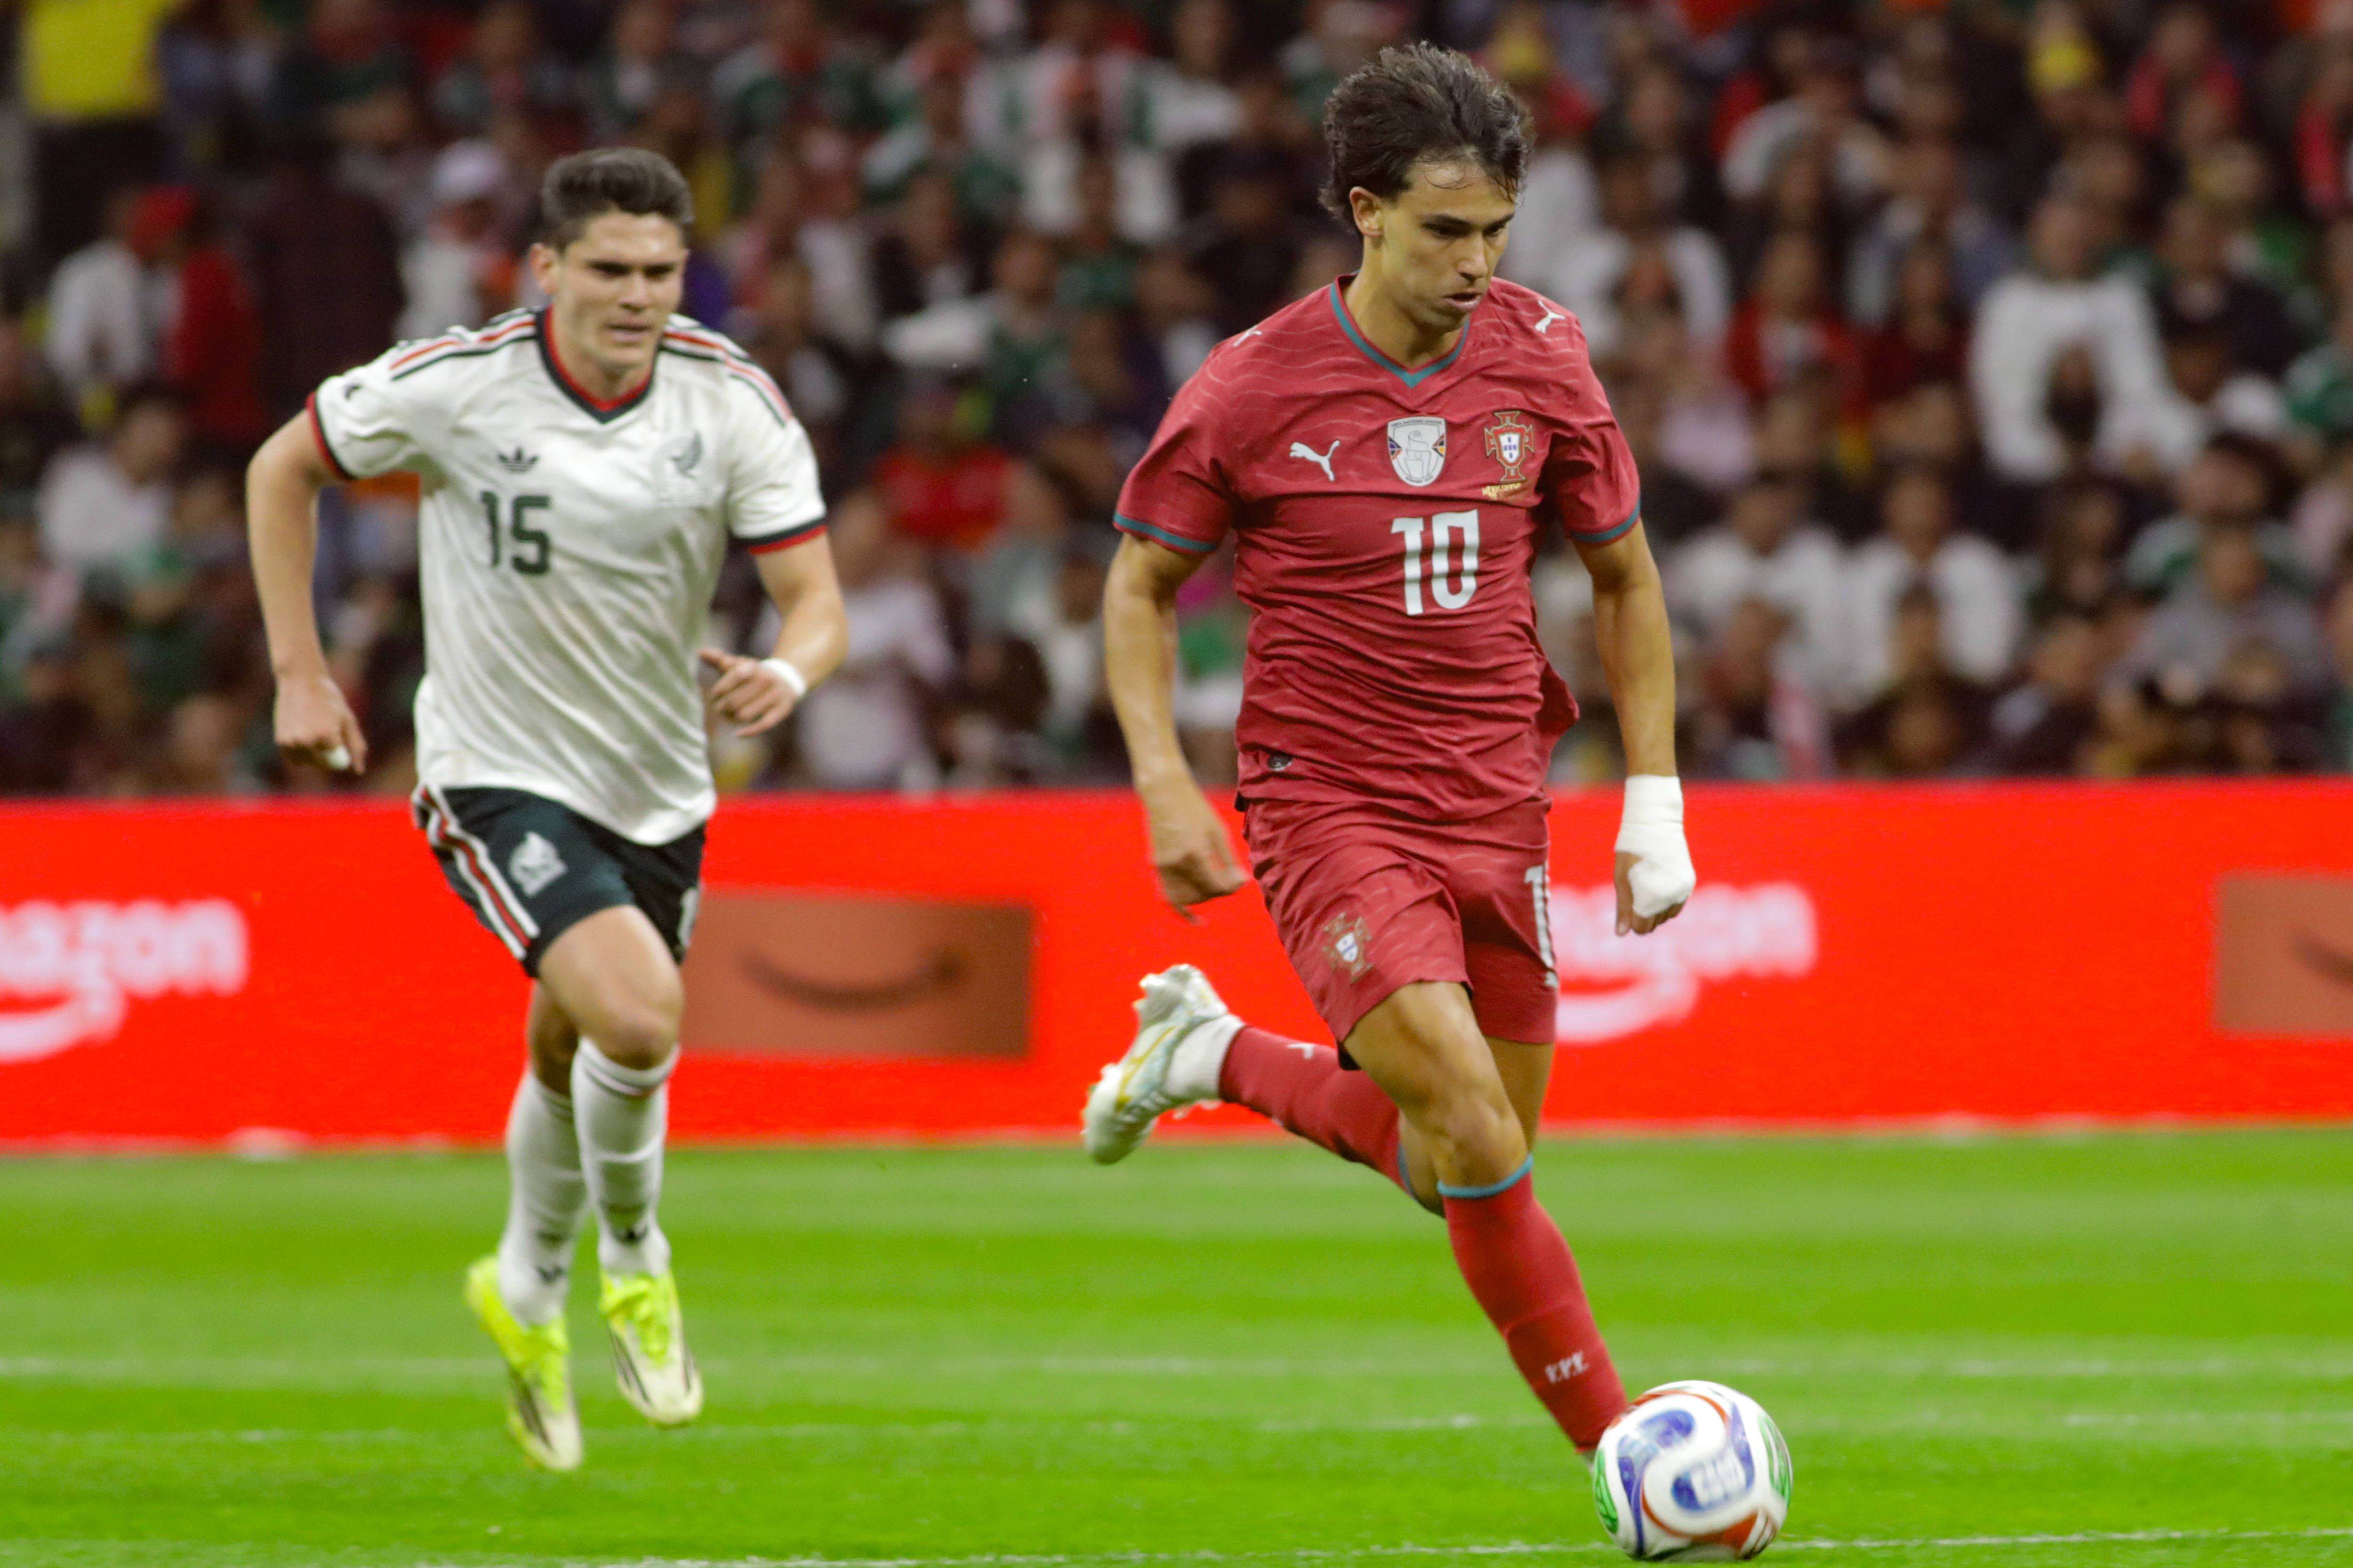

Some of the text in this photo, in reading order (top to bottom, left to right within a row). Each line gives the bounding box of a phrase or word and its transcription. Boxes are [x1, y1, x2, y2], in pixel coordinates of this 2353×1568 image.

[480, 489, 551, 576] 15
[1390, 508, 1480, 616] 10
[0, 900, 249, 997] azon
